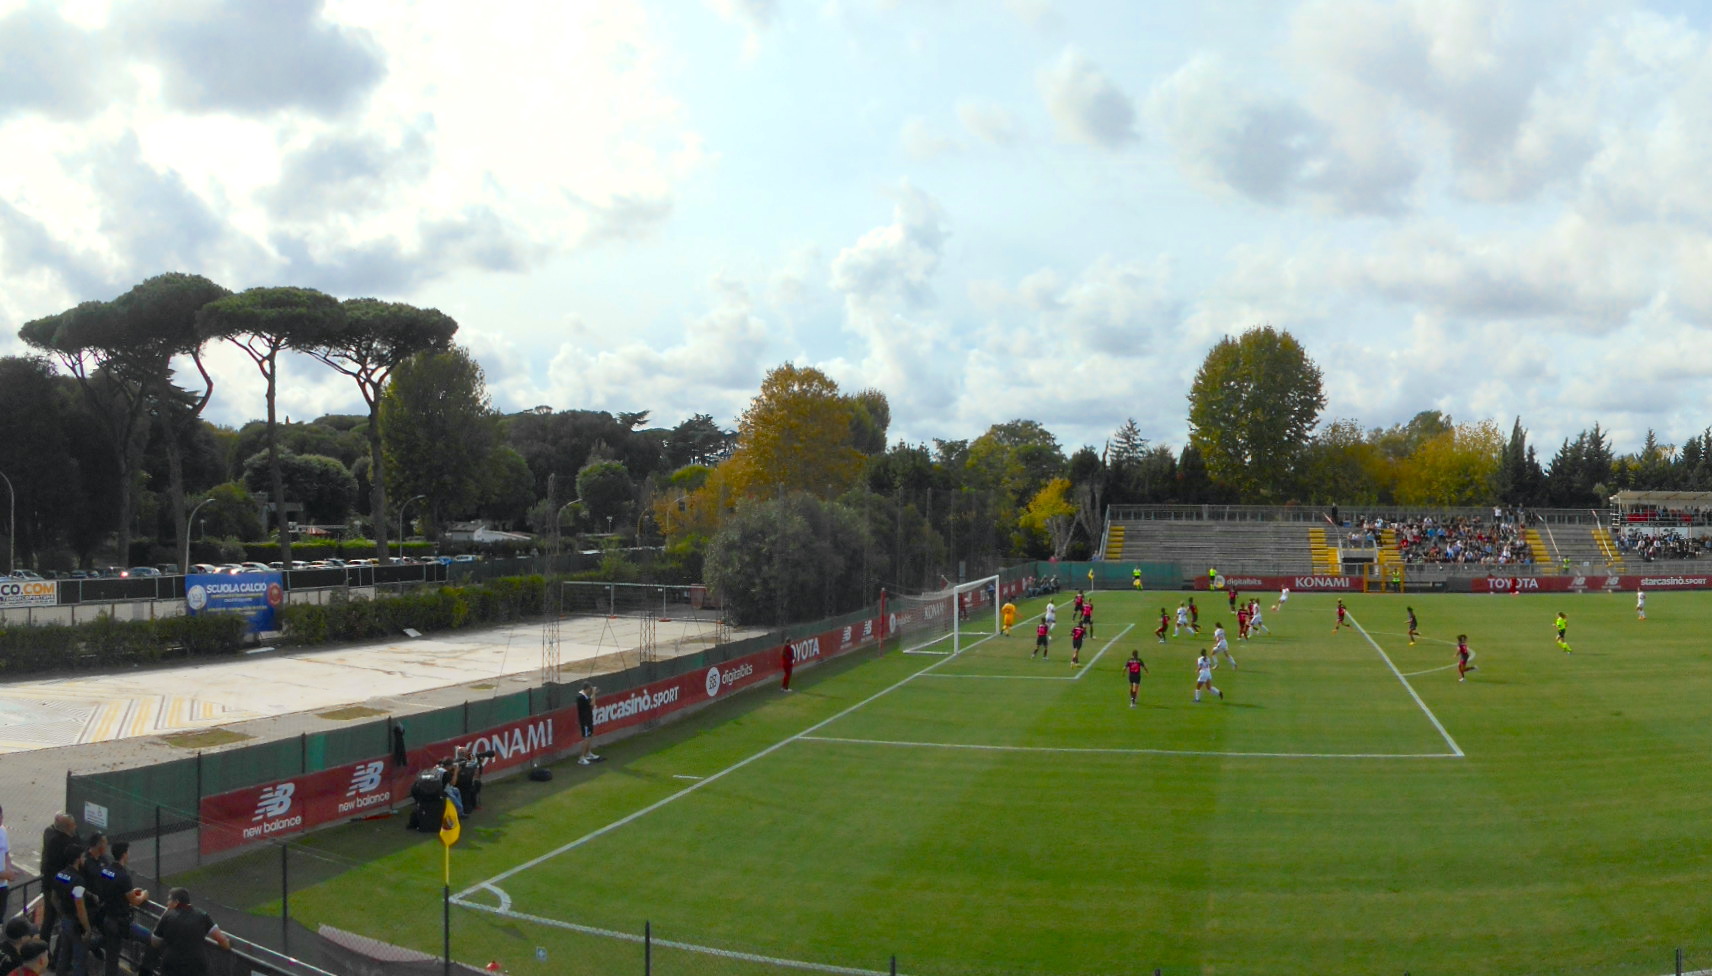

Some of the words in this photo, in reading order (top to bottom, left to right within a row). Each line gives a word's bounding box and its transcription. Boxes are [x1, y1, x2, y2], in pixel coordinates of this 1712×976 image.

[207, 584, 240, 594] SCUOLA
[240, 582, 267, 593] CALCIO
[1295, 576, 1351, 588] KONAMI
[593, 686, 680, 726] tarcasinò.SPORT
[338, 801, 355, 813] new
[356, 791, 390, 809] balance
[243, 827, 262, 839] new
[263, 815, 302, 834] balance
